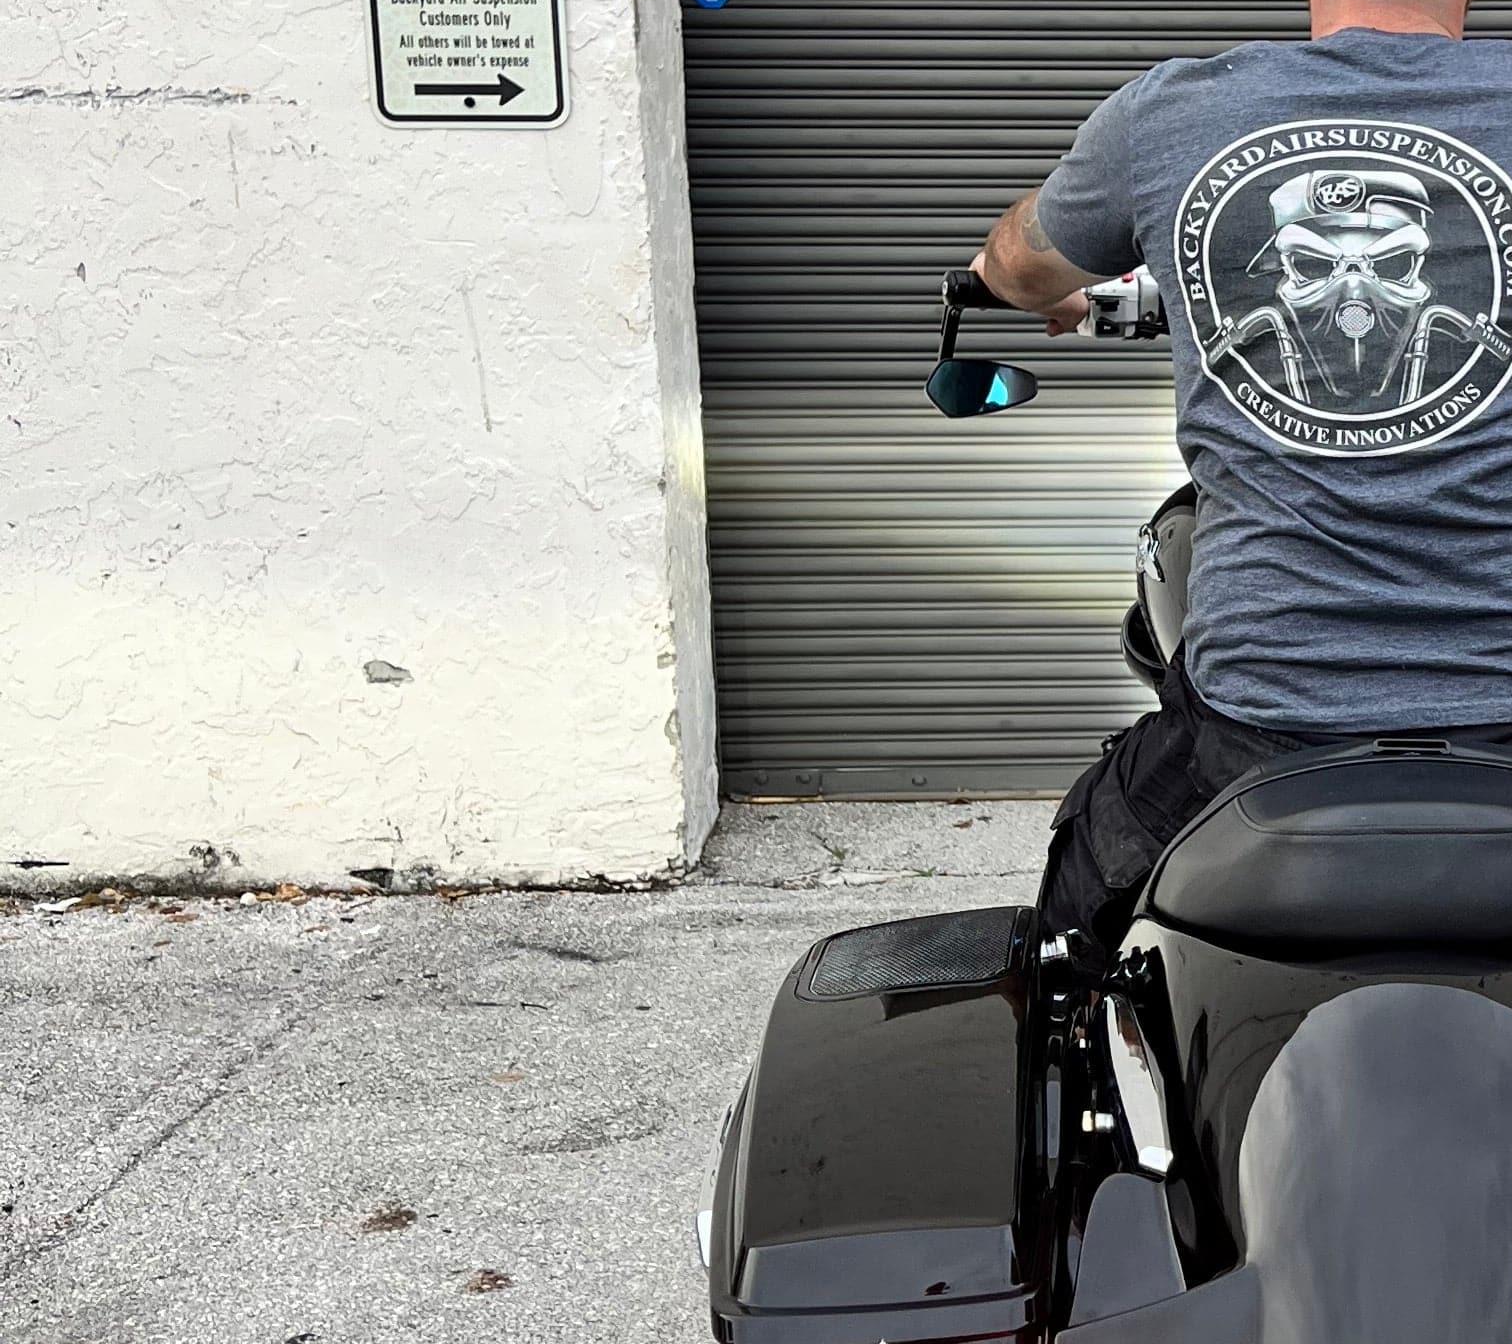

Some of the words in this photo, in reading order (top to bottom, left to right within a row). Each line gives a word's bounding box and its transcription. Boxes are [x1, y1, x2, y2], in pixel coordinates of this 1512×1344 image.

[419, 11, 479, 26] Customers
[484, 11, 511, 30] Only
[400, 35, 414, 49] All
[418, 35, 450, 49] others
[453, 35, 472, 49] will
[475, 35, 488, 49] be
[491, 35, 520, 49] towed
[524, 36, 535, 49] at
[407, 54, 443, 67] vehicle
[446, 54, 486, 68] owner's
[490, 57, 529, 70] expense
[1236, 381, 1331, 446] CREATIVE
[1335, 382, 1482, 447] INNOVATIONS
